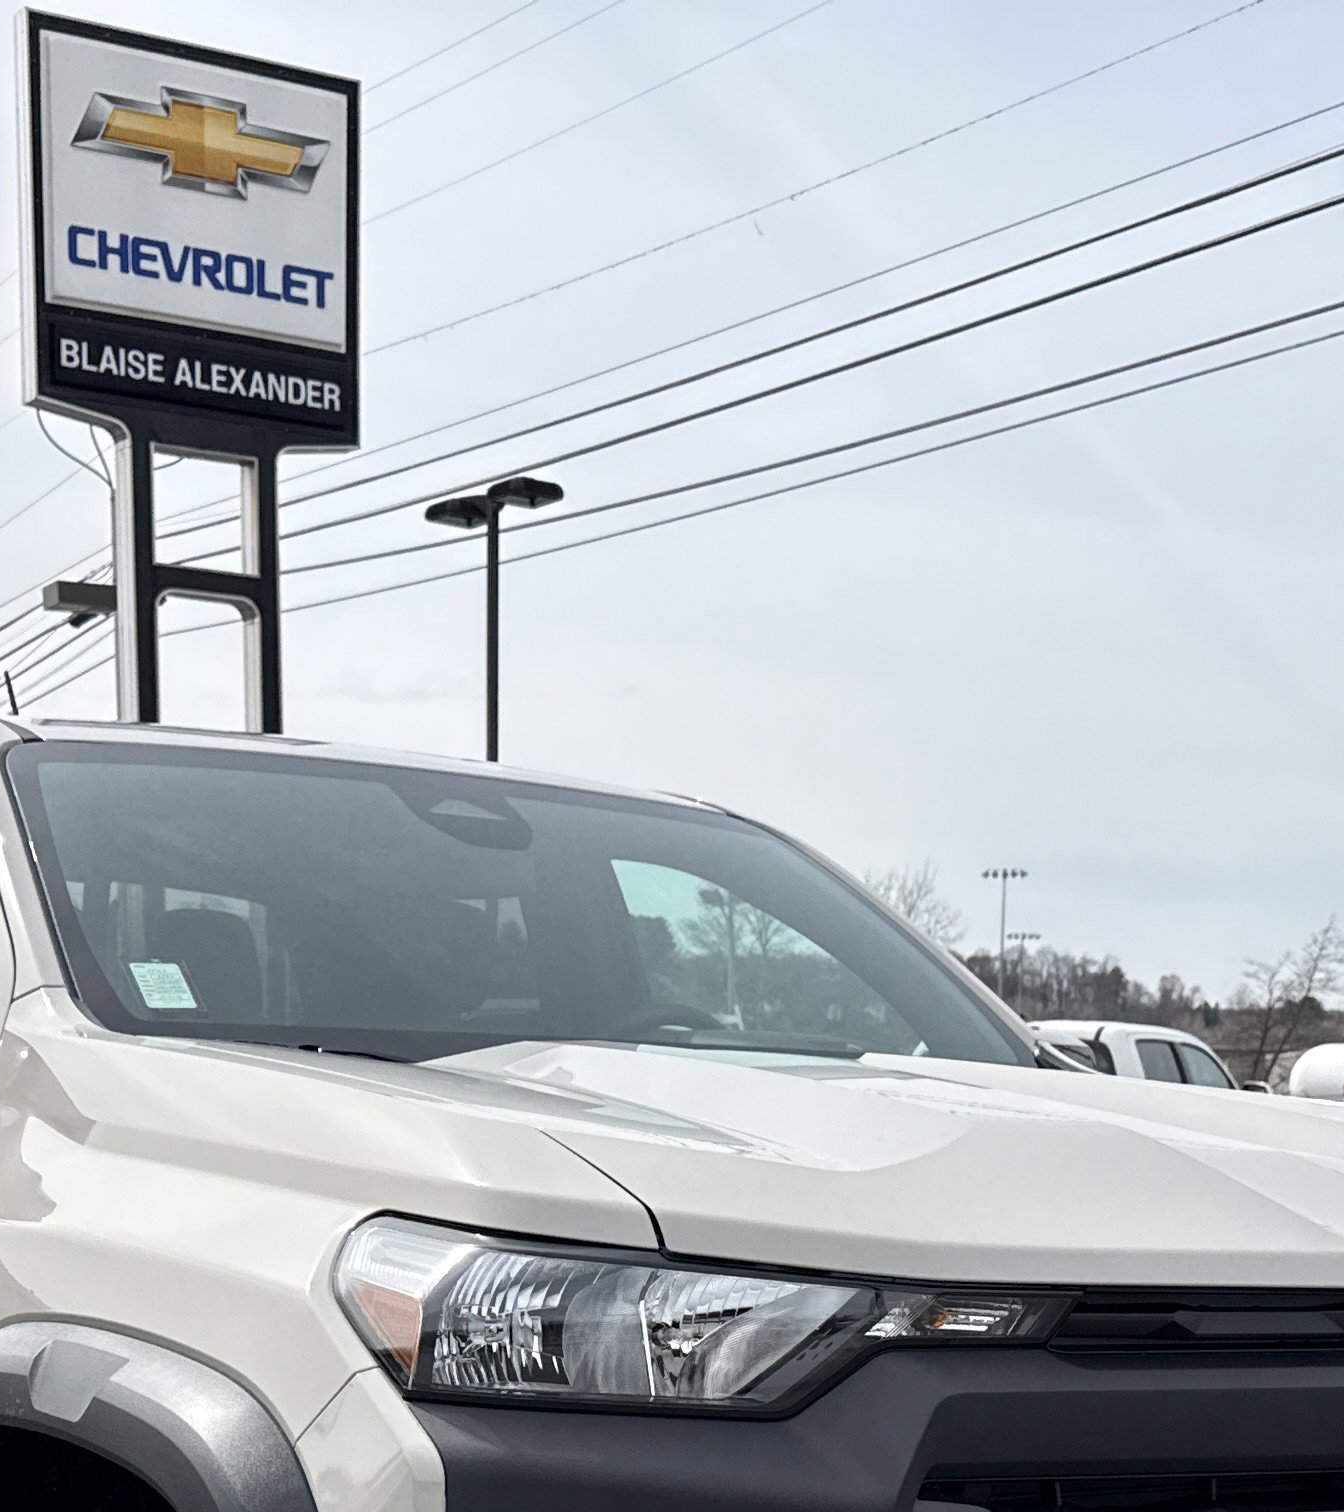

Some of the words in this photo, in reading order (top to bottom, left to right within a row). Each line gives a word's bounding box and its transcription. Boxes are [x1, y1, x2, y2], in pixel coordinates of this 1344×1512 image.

[68, 224, 334, 309] CHEVROLET
[59, 337, 166, 384] BLAISE
[174, 358, 342, 413] ALEXANDER
